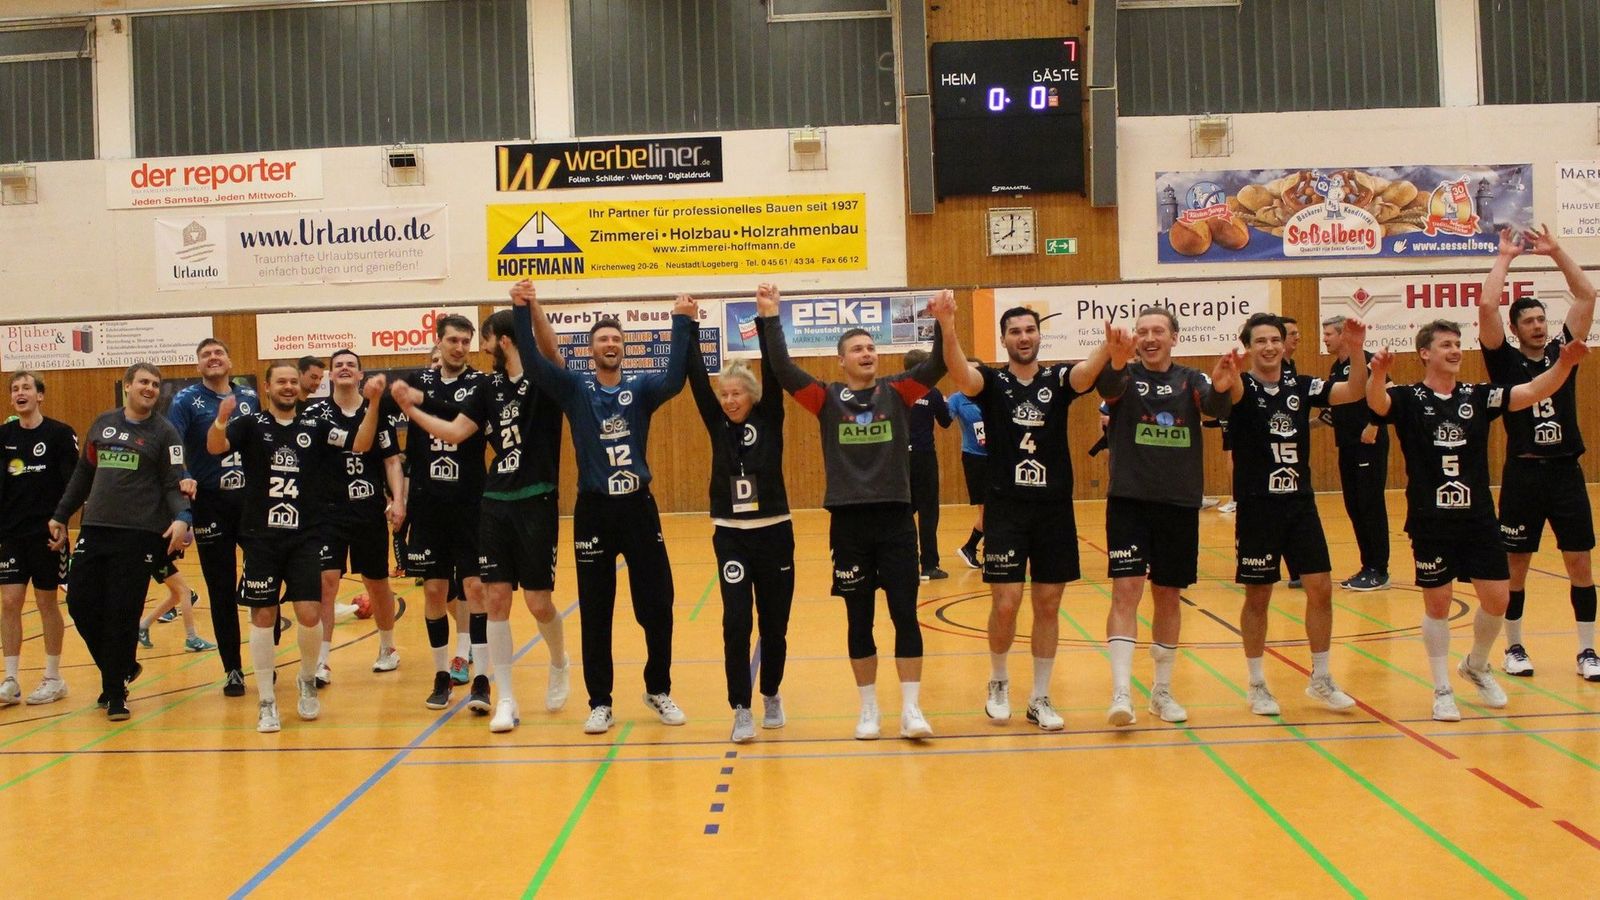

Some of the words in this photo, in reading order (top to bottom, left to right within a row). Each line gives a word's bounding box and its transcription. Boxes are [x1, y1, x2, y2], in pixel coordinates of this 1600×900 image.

[1063, 41, 1076, 62] 7
[941, 73, 977, 86] HEIM
[1032, 68, 1079, 83] GÄSTE
[988, 87, 1005, 111] 0
[1030, 85, 1046, 110] 0
[130, 163, 177, 189] der
[183, 158, 297, 190] reporter
[595, 174, 625, 182] Schilder
[630, 173, 663, 182] Werbung
[668, 171, 711, 180] Digitaldruck
[131, 197, 162, 206] Jeden
[164, 195, 213, 205] Samstag.
[214, 193, 245, 203] Jeden
[248, 190, 297, 200] Mittwoch.
[1452, 185, 1465, 196] 30
[589, 208, 605, 218] Ihr
[608, 206, 649, 218] Partner
[653, 206, 669, 217] für
[673, 203, 763, 218] professionelles
[766, 203, 803, 213] Bauen
[806, 201, 828, 212] seit
[831, 200, 859, 211] 1937
[240, 216, 435, 248] www.Urlando.de
[590, 229, 660, 243] Zimmerei
[670, 226, 731, 240] Holzbau
[741, 223, 859, 238] Holzrahmenbau
[1287, 223, 1376, 249] Seßelberg
[653, 241, 796, 254] www.zimmerei-hoffmann.de
[1412, 240, 1498, 253] www.sesselberg.
[253, 252, 316, 265] Traumhafte
[317, 248, 424, 262] Urlaubsunterkünfte
[591, 263, 636, 272] Kirchenweg
[637, 262, 659, 270] 20-26
[745, 259, 759, 267] Tel.
[821, 256, 836, 265] Fax
[173, 264, 219, 279] Urlando
[258, 266, 299, 278] einfach
[300, 264, 340, 276] buchen
[342, 263, 364, 274] und
[365, 260, 420, 275] genießen!
[497, 256, 585, 276] HOFFMANN
[791, 300, 883, 327] eska
[55, 331, 66, 344] &
[273, 334, 304, 343] Jeden
[307, 332, 357, 341] Mittwoch.
[372, 325, 440, 352] report
[803, 326, 841, 335] Neustadt
[1177, 325, 1216, 335] rwachsene
[274, 343, 304, 351] Jeden
[307, 341, 357, 351] Samstag.
[1532, 397, 1556, 418] 13
[118, 432, 130, 441] 16
[500, 425, 522, 449] 21
[843, 424, 887, 437] AHOI
[1141, 427, 1186, 439] AHOI
[1019, 432, 1037, 454] 4
[100, 452, 135, 463] AHOI
[606, 444, 632, 467] 12
[1270, 442, 1299, 464] 15
[346, 457, 364, 475] 55
[1441, 454, 1460, 477] 5
[269, 476, 299, 499] 24
[736, 479, 752, 500] D
